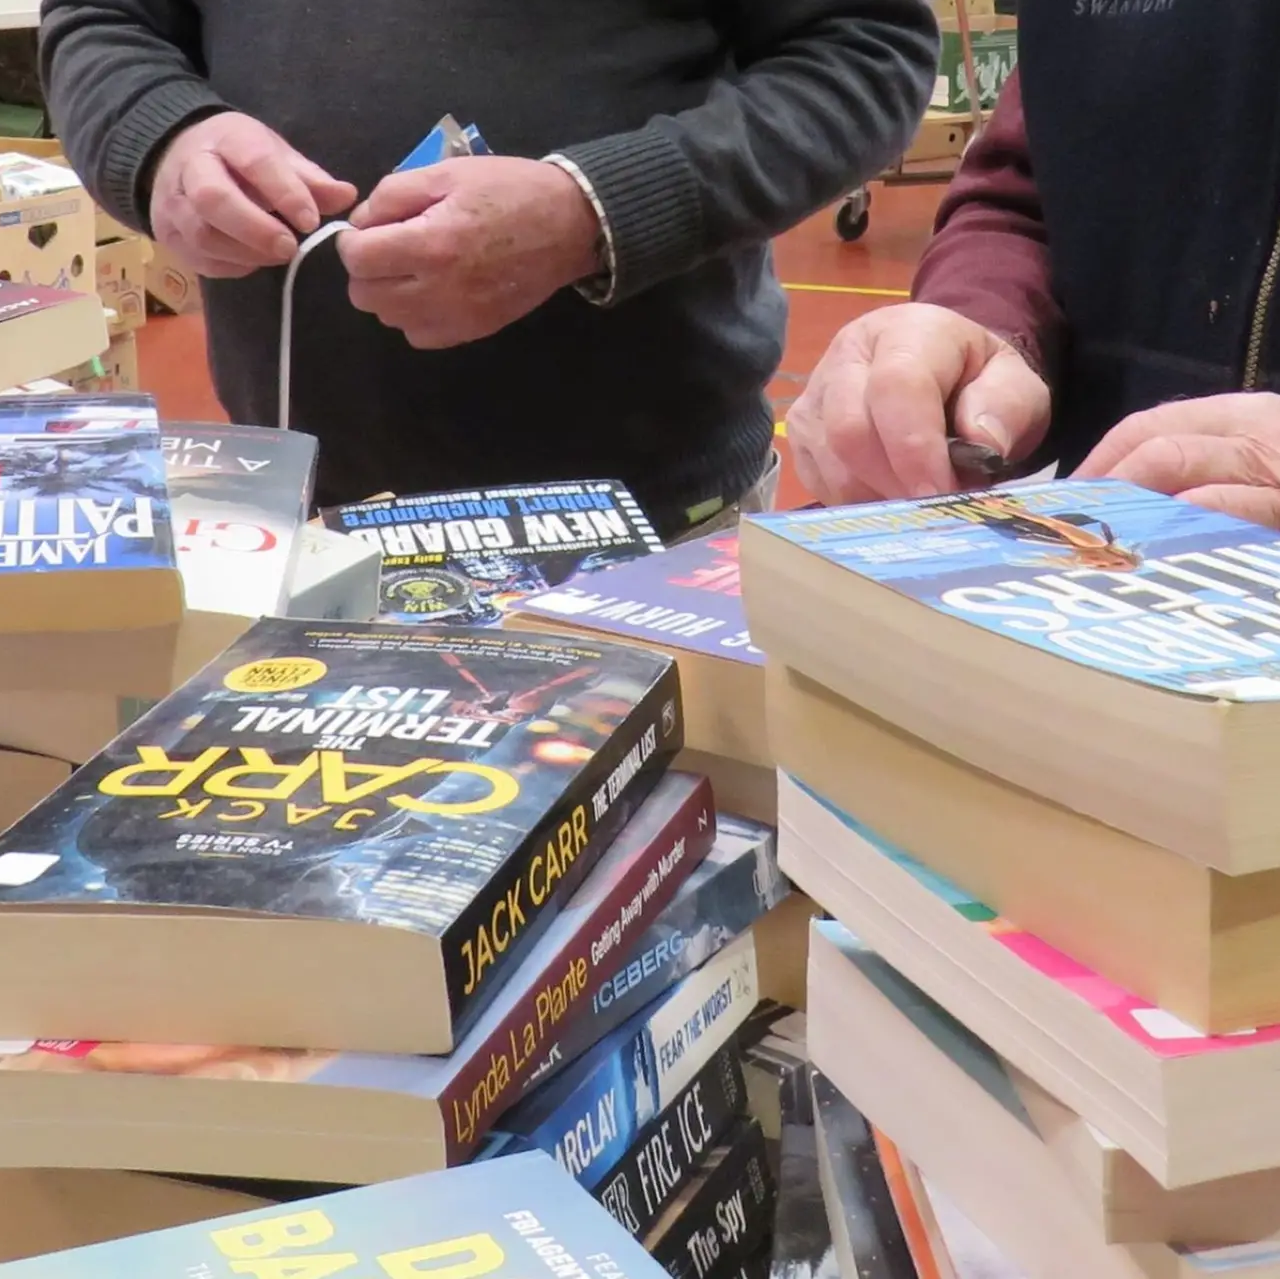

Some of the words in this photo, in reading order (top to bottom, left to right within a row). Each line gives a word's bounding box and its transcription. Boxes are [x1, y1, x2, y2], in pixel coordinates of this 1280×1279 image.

[236, 456, 271, 472] A
[338, 500, 392, 514] Author
[395, 490, 482, 508] Bestselling
[484, 484, 583, 501] International
[515, 492, 617, 516] Robert
[341, 498, 510, 529] Muchamore
[522, 508, 630, 547] NEW
[413, 553, 443, 564] Daily
[322, 684, 450, 711] LIST
[229, 705, 500, 749] TERMINAL
[312, 734, 367, 751] THE
[96, 745, 521, 816] CARR
[157, 797, 377, 831] JACK
[176, 833, 261, 848] SERIES
[460, 878, 527, 996] JACK
[528, 803, 590, 907] CARR
[591, 783, 610, 822] THE
[606, 742, 643, 804] TERMINAL
[640, 722, 657, 763] LIST
[592, 928, 687, 1015] ICEBERG
[451, 1053, 511, 1145] Lynda
[510, 1022, 538, 1073] La
[534, 956, 590, 1041] Plante
[589, 922, 624, 967] Getting
[621, 888, 644, 933] Away
[642, 868, 660, 906] with
[657, 835, 688, 884] Murder
[658, 1033, 686, 1076] FEAR
[682, 1014, 706, 1049] THE
[700, 979, 735, 1034] WORST
[635, 1120, 683, 1216] FIRE
[676, 1081, 714, 1166] ICE
[503, 1209, 547, 1241] FBI
[686, 1224, 720, 1279] The
[715, 1188, 749, 1244] Spy
